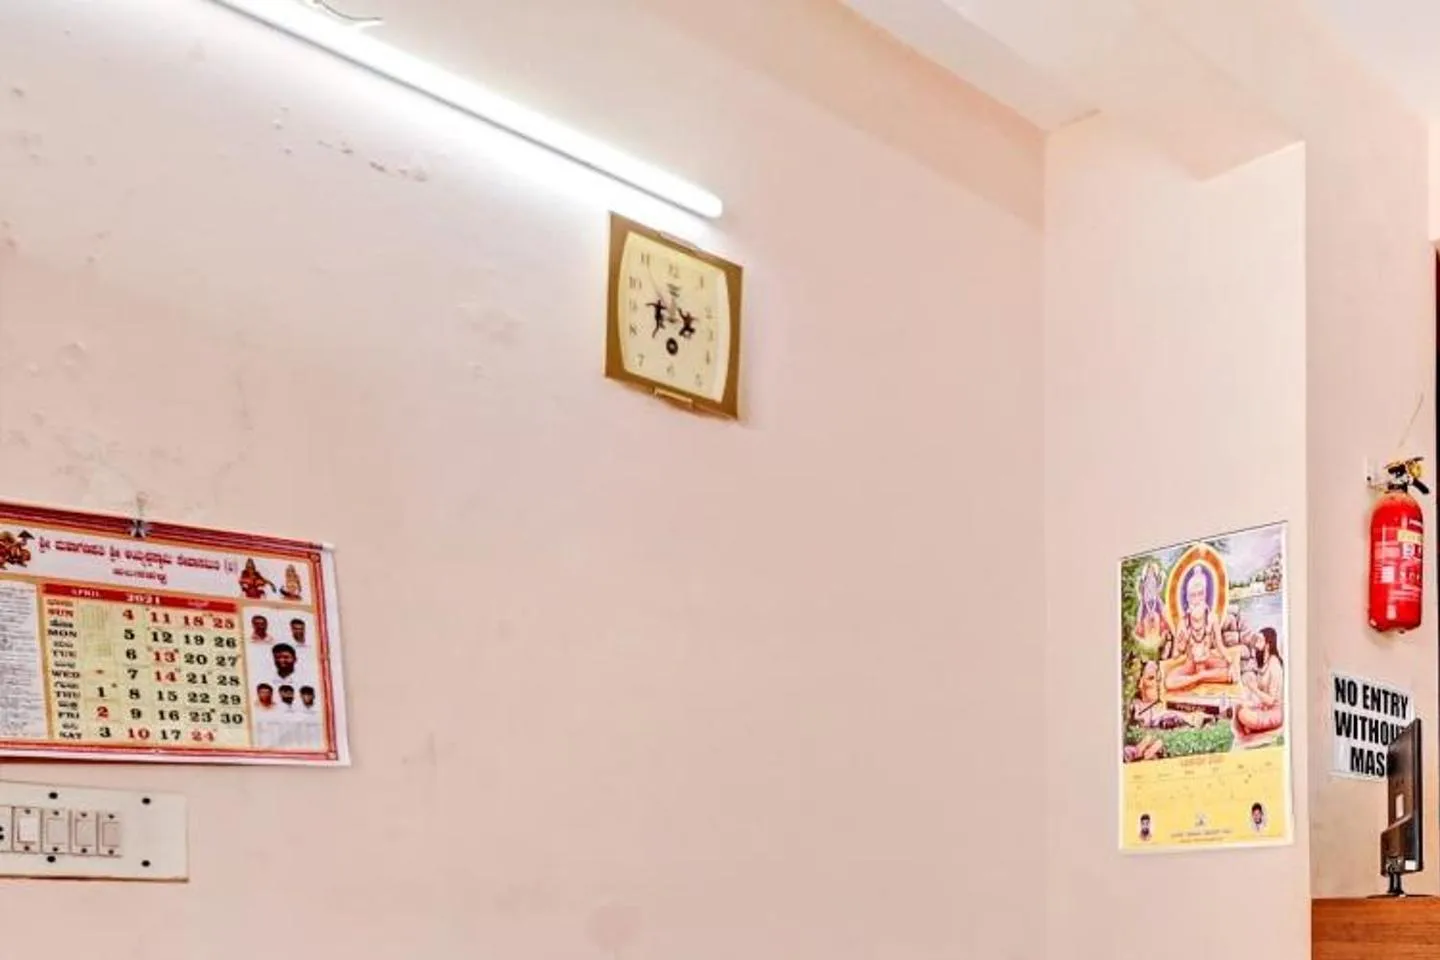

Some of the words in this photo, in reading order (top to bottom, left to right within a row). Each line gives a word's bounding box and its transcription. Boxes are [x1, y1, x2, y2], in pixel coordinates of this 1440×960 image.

[48, 608, 74, 617] SUN
[122, 609, 134, 620] 4
[151, 612, 171, 624] 11
[184, 615, 204, 626] 18
[213, 618, 235, 629] 25
[47, 629, 77, 638] MON
[124, 629, 135, 640] 5
[152, 631, 173, 643] 12
[184, 634, 205, 645] 19
[214, 637, 236, 648] 26
[53, 649, 77, 658] TUE
[126, 649, 137, 660] 6
[153, 651, 176, 662] 13
[184, 653, 208, 665] 20
[216, 656, 237, 667] 27
[52, 670, 80, 679] WED
[127, 669, 138, 680] 7
[155, 671, 176, 682] 14
[186, 672, 208, 684] 21
[217, 675, 240, 686] 28
[55, 690, 81, 699] THU
[97, 686, 105, 698] 1
[129, 688, 141, 700] 8
[157, 690, 178, 701] 15
[187, 692, 210, 703] 22
[219, 694, 241, 705] 29
[1334, 677, 1358, 707] NO
[1362, 684, 1408, 720] ENTRY
[58, 711, 80, 719] FRI
[97, 706, 109, 718] 2
[130, 708, 142, 720] 9
[158, 710, 180, 721] 16
[189, 711, 212, 722] 23
[220, 713, 243, 724] 30
[59, 731, 82, 740] SAT
[99, 727, 111, 738] 3
[128, 728, 150, 739] 10
[161, 729, 181, 740] 17
[191, 730, 214, 741] 24
[1334, 710, 1404, 746] WITHOU
[1350, 746, 1387, 778] MAS
